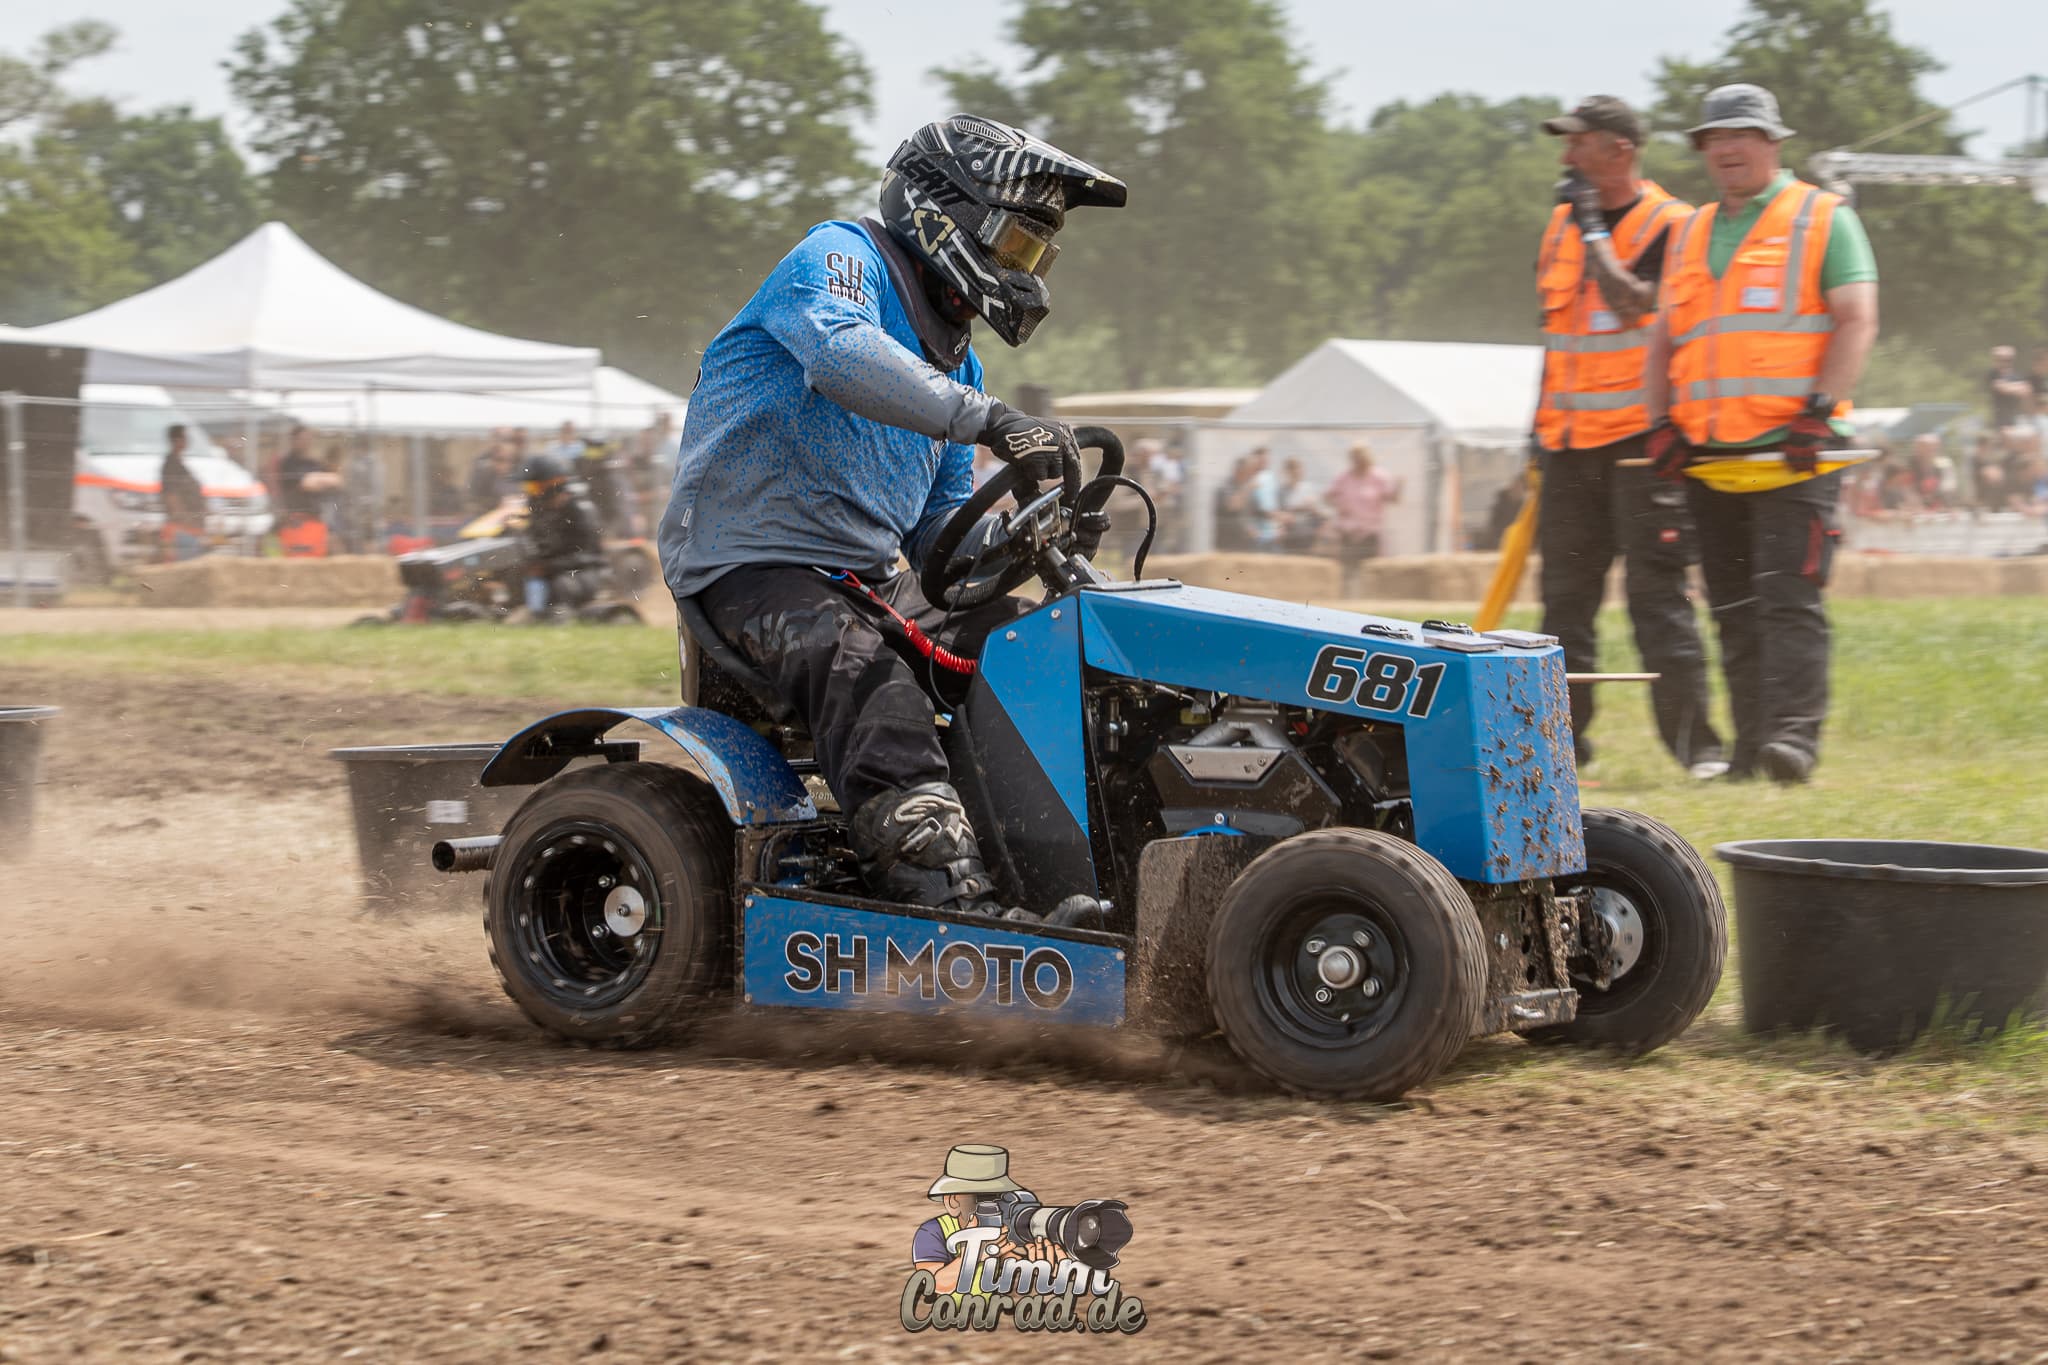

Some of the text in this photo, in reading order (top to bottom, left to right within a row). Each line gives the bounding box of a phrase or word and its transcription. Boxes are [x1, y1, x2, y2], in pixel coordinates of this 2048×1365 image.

[825, 251, 864, 291] SH
[1306, 643, 1447, 719] 681
[784, 930, 1074, 1009] SH MOTO
